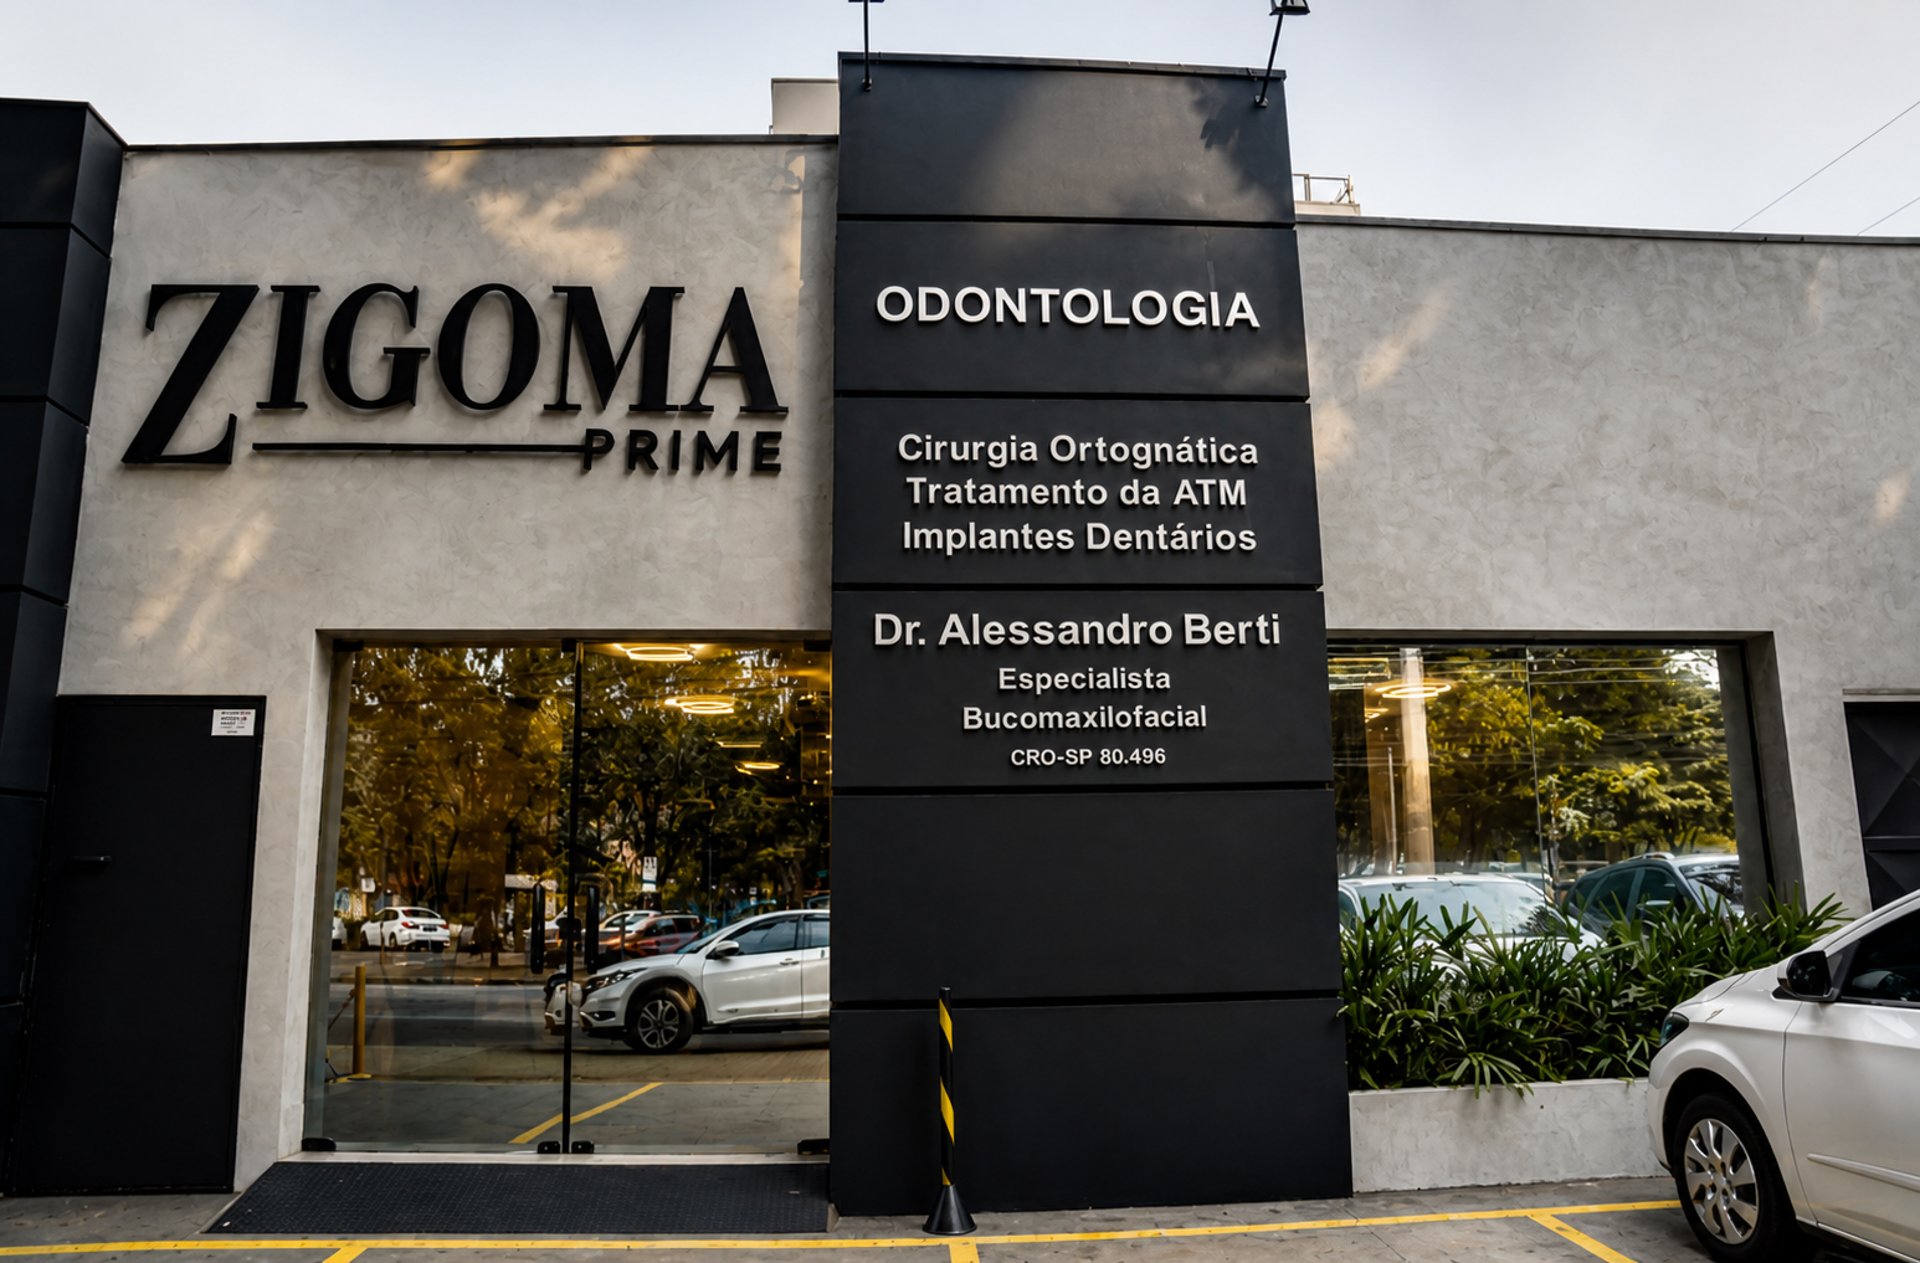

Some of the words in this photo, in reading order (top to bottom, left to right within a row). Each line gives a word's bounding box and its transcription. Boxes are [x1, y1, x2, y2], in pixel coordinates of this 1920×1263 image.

[876, 286, 1260, 328] ODONTOLOGIA
[121, 282, 789, 465] ZIGOMA
[583, 428, 782, 473] PRIME
[898, 433, 1038, 468] Cirurgia
[1050, 434, 1258, 470] Ortognática
[906, 477, 1108, 506] Tratamento
[1120, 479, 1160, 506] da
[1173, 479, 1247, 506] ATM
[903, 522, 1075, 556] Implantes
[1086, 522, 1258, 551] Dentários
[874, 613, 926, 646] Dr.
[938, 613, 1173, 646] Alessandro
[1184, 613, 1281, 645] Berti
[998, 667, 1171, 695] Especialista
[963, 705, 1207, 730] Bucomaxilofacial
[1011, 748, 1092, 766] CRO-SP
[1100, 748, 1166, 765] 80.496
